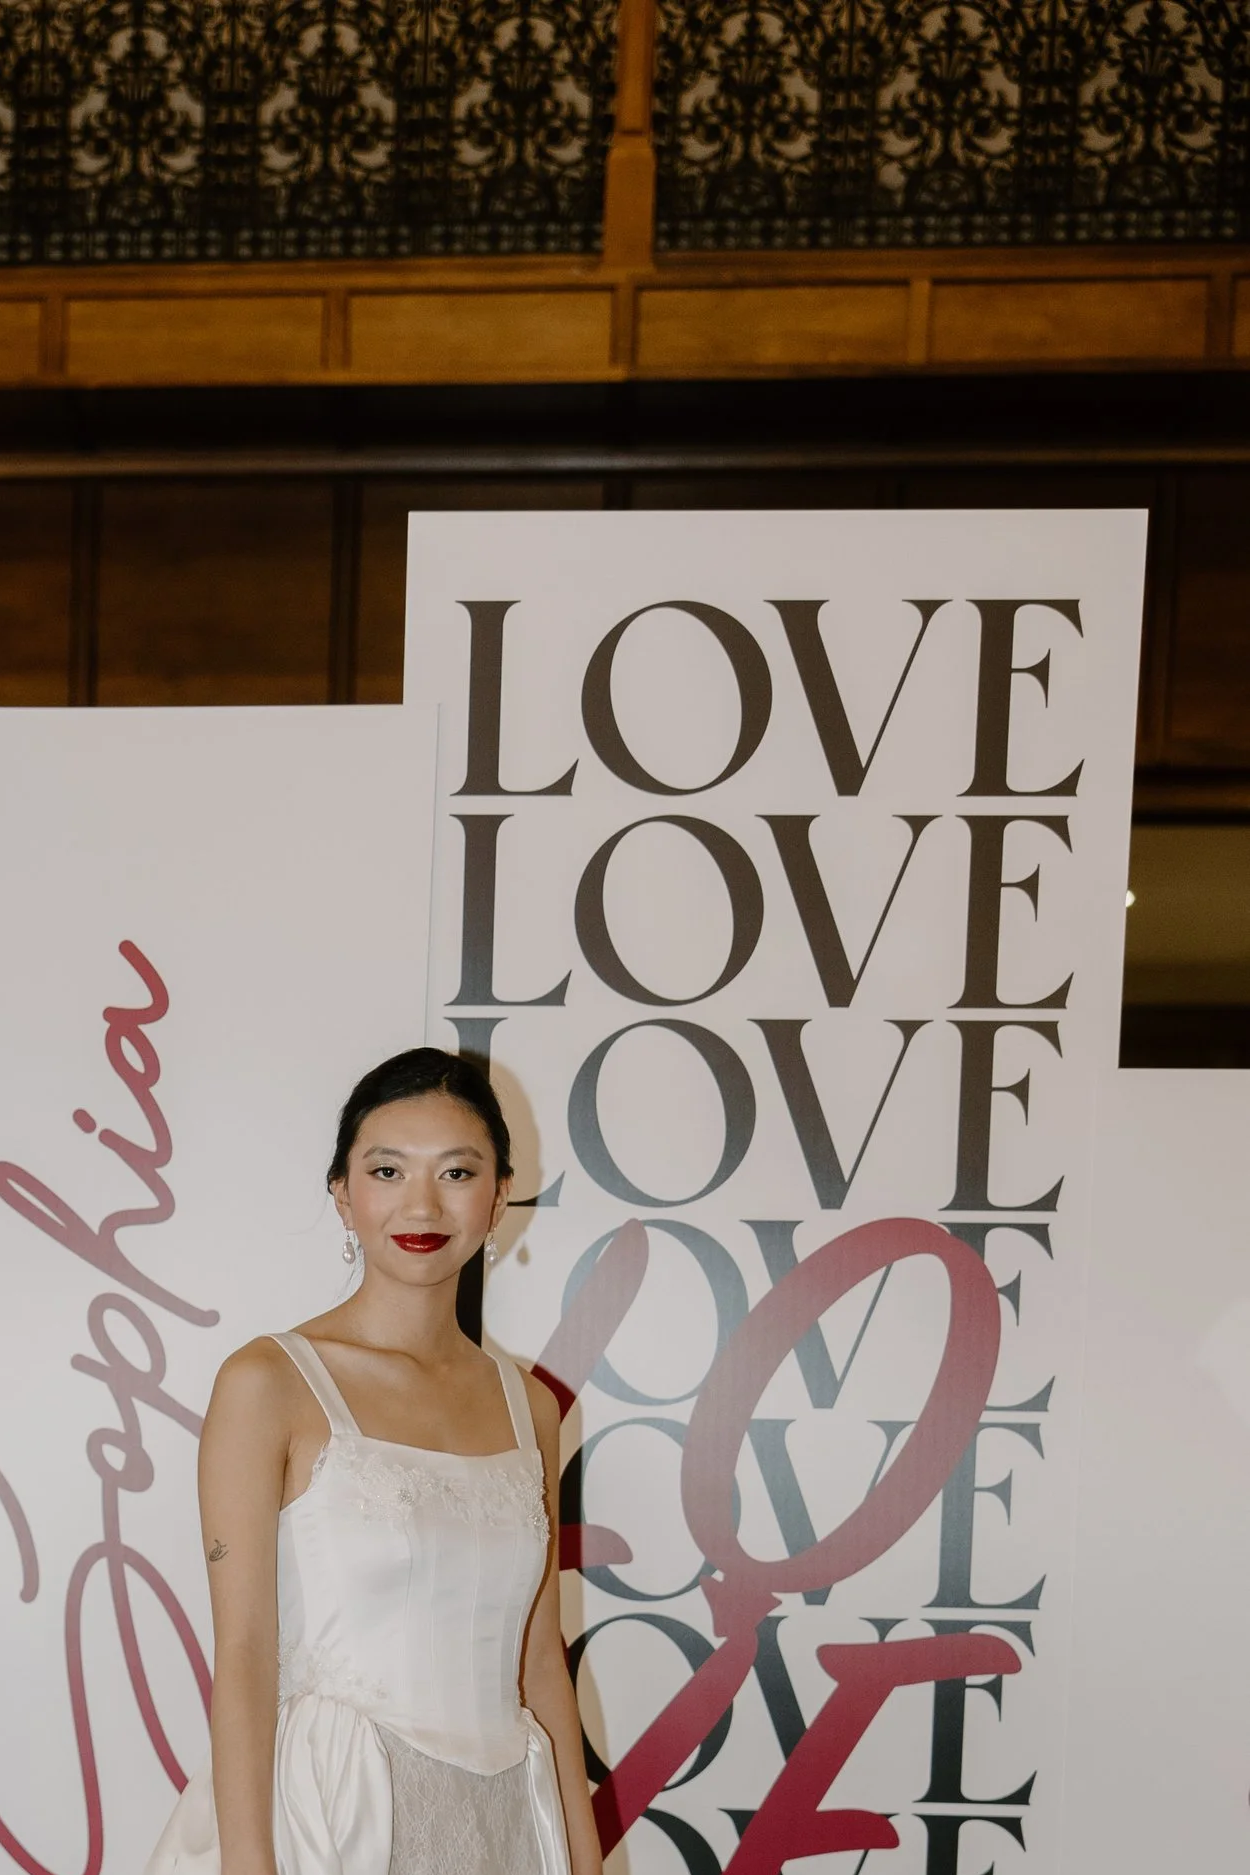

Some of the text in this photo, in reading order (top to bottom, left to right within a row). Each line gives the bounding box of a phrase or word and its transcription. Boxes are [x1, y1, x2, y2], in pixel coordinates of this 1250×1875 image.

[449, 599, 1085, 798] LOVE
[443, 813, 1075, 1010] LOVE
[559, 1416, 1047, 1611] OVE
[567, 1613, 1038, 1807] OVE
